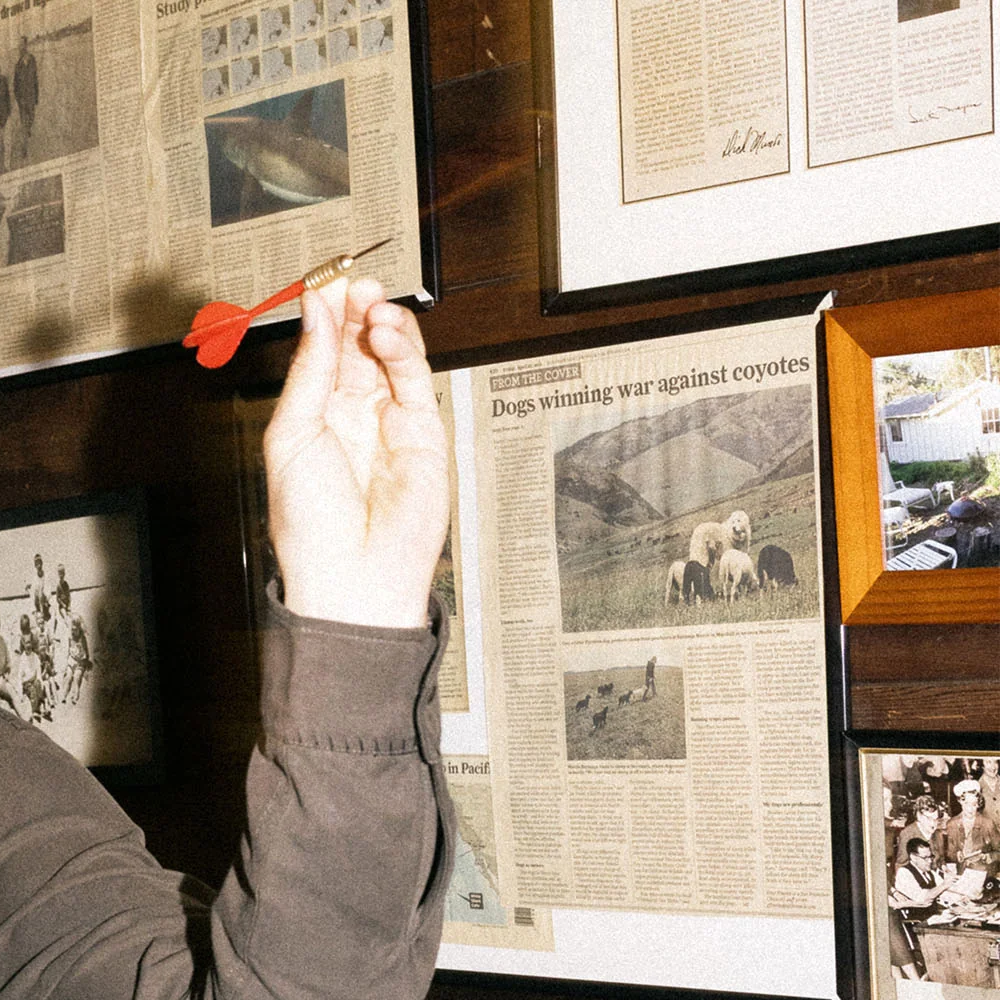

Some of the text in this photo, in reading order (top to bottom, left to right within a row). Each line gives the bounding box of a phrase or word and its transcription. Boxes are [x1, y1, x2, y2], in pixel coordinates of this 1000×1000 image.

[491, 365, 581, 391] FROM THE COVER
[491, 355, 810, 418] Dogs winning war against coyotes
[447, 761, 459, 775] in
